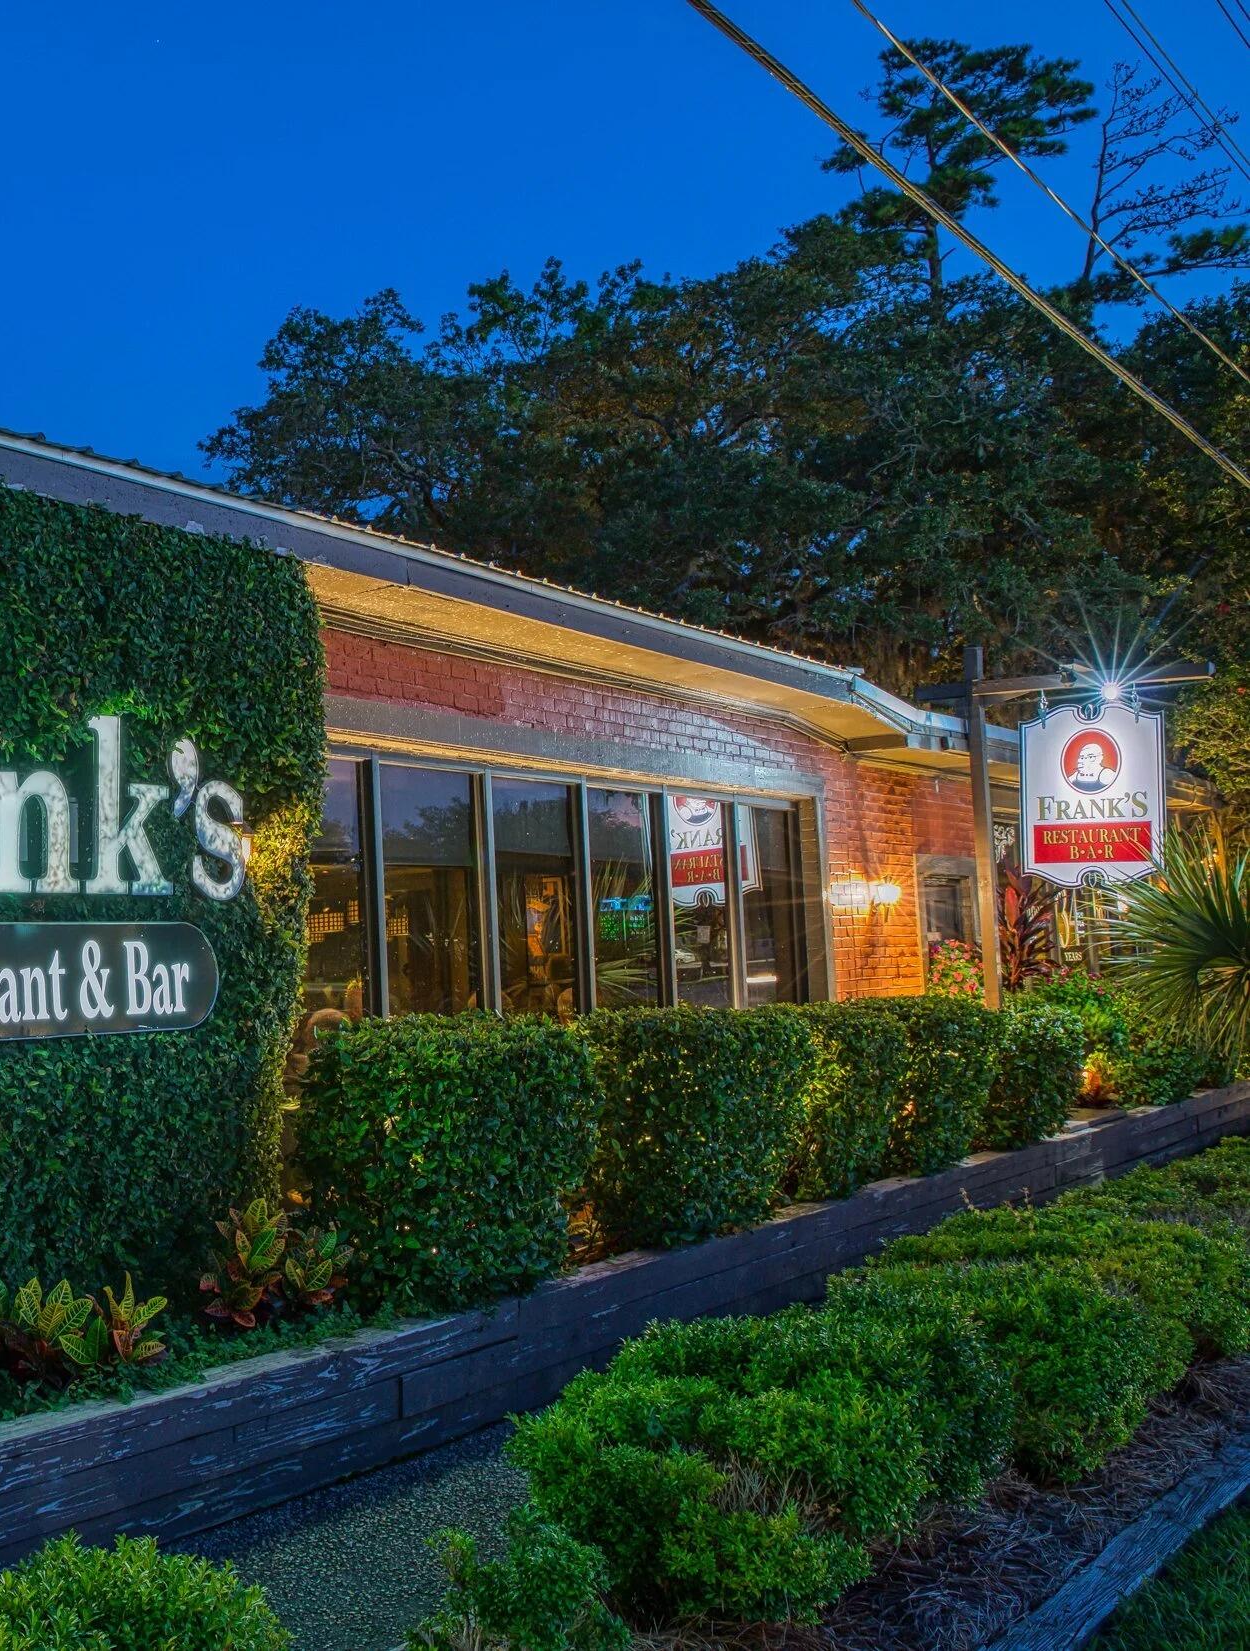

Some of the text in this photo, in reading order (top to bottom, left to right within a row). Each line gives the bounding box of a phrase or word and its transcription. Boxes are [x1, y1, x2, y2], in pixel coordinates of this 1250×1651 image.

[1036, 791, 1149, 820] FRANK'S
[1043, 827, 1141, 845] RESTAURANT
[79, 939, 114, 1020] &
[122, 940, 189, 1016] Bar
